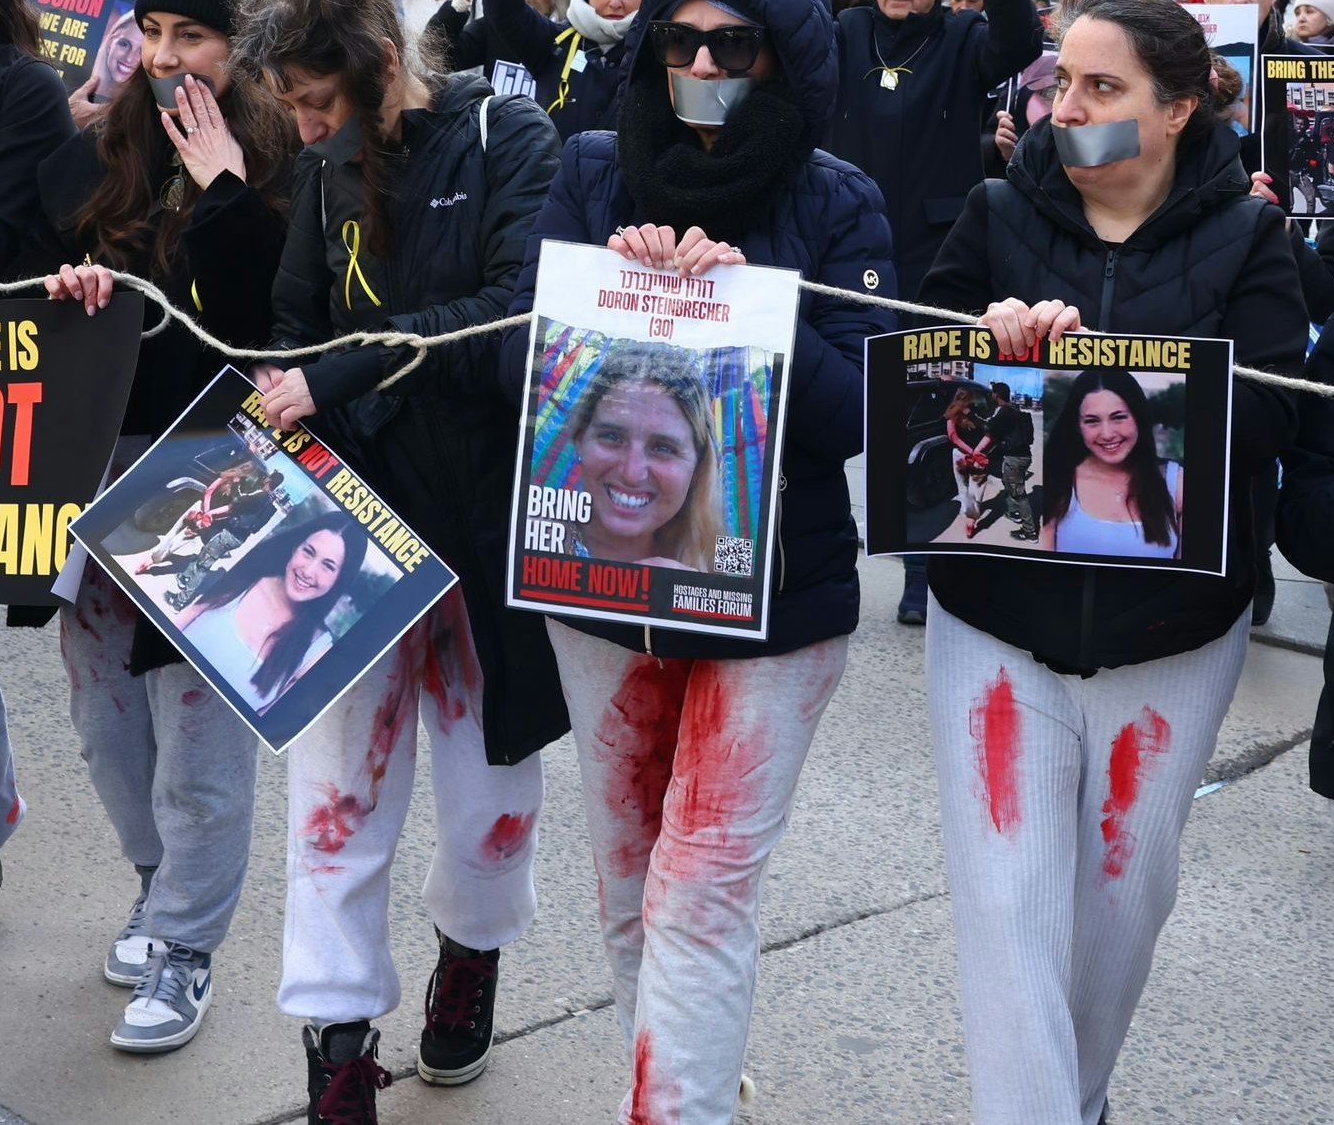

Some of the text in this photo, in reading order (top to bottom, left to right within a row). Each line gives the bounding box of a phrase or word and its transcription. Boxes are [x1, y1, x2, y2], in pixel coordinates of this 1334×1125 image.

[39, 11, 89, 40] WE ARE
[60, 43, 88, 66] FOR
[1267, 60, 1306, 79] BRING
[597, 289, 731, 323] DORON STEINBRECHER
[649, 316, 674, 340] (30)
[8, 320, 39, 371] IS
[903, 330, 962, 361] RAPE
[969, 330, 991, 360] IS
[1049, 337, 1192, 369] RESISTANCE
[283, 428, 430, 574] IS NOT RESISTANCE
[527, 484, 592, 523] BRING
[524, 518, 566, 554] HER
[522, 555, 651, 601] HOME NOW!
[673, 583, 753, 603] HOSTAGES AND MISSING
[672, 595, 752, 618] FAMILIES FORUM
